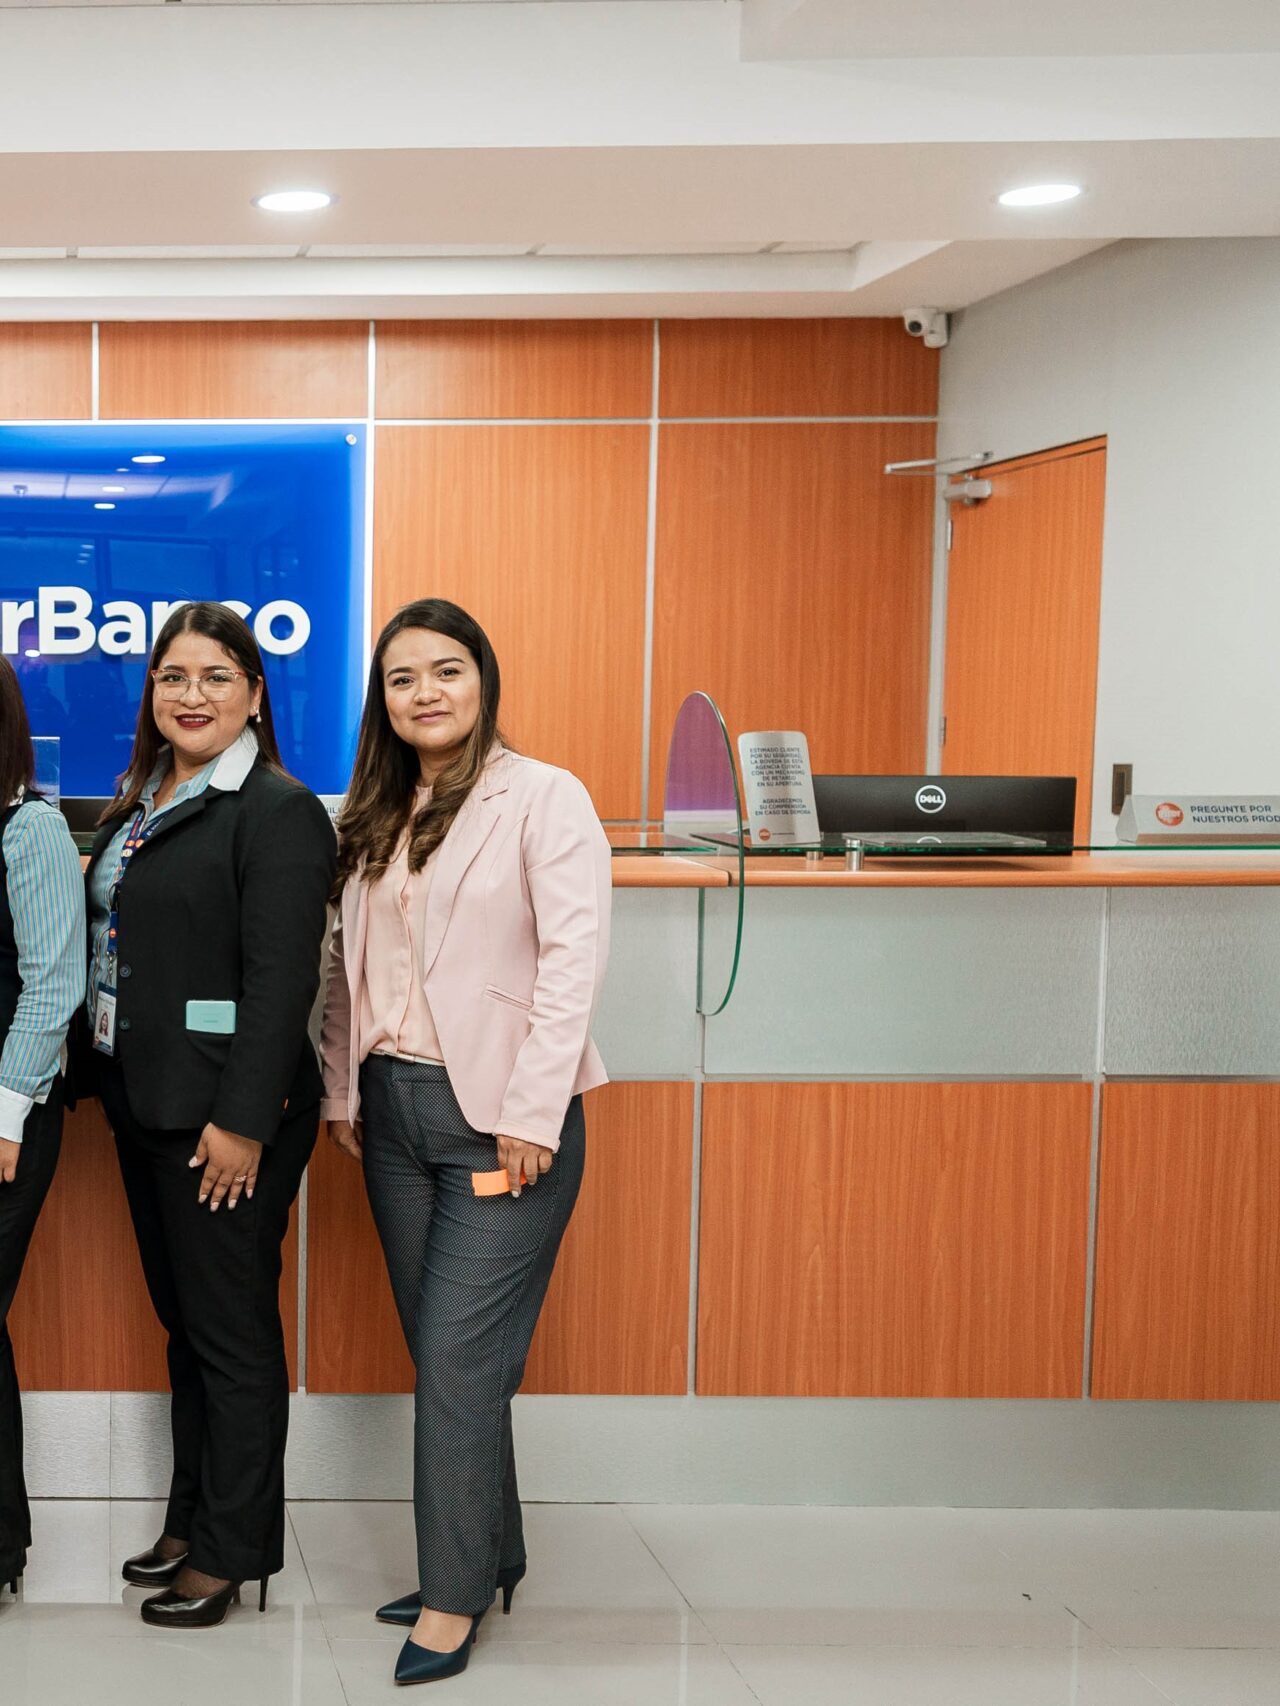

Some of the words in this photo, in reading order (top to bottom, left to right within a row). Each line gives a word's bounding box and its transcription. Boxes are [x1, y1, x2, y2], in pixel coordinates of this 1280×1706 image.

[919, 794, 943, 804] DELL
[1190, 805, 1247, 813] PREGUNTE
[1249, 805, 1272, 813] POR
[1192, 815, 1249, 823] NUESTROS
